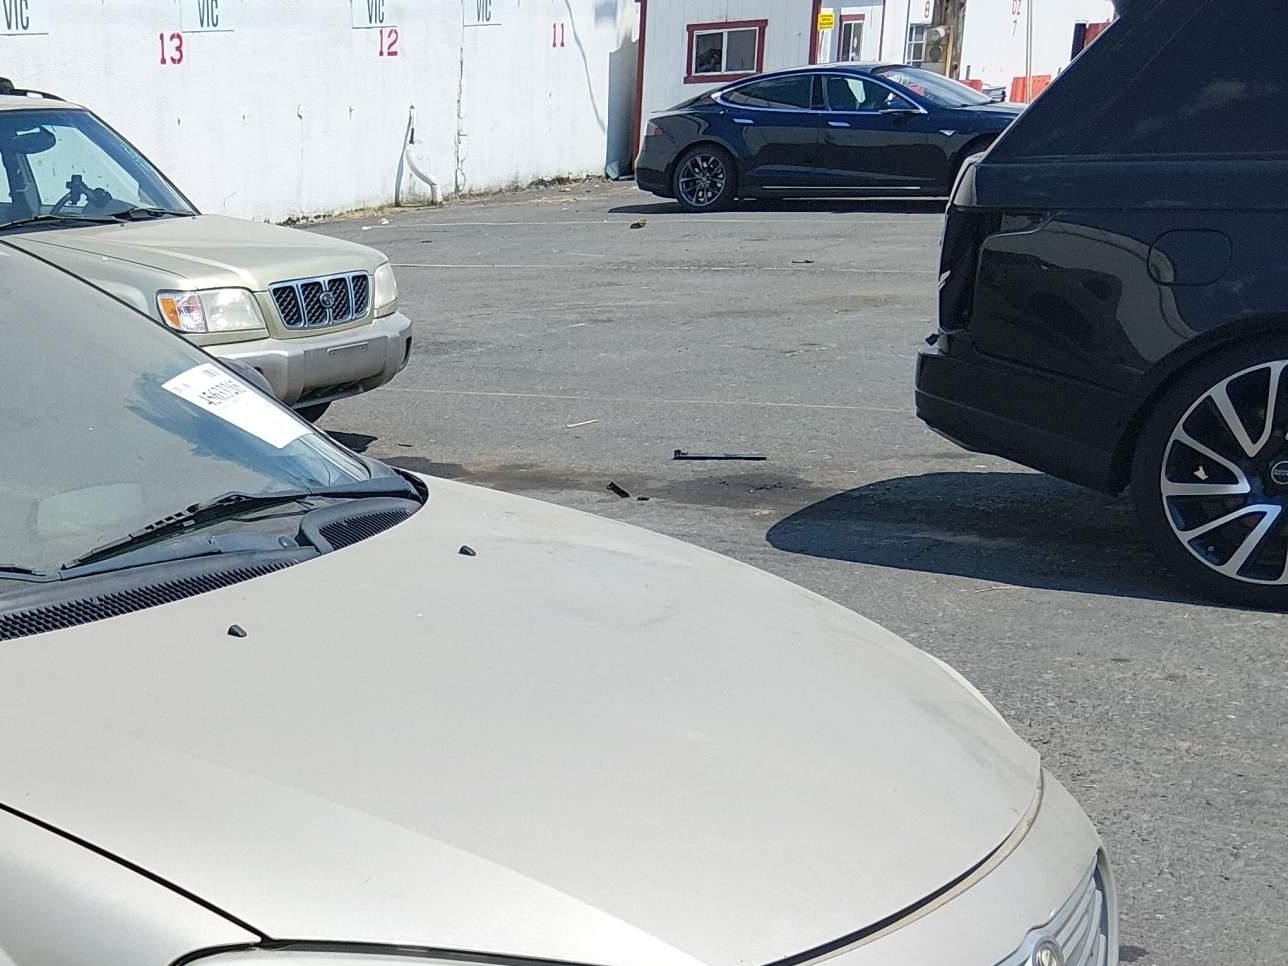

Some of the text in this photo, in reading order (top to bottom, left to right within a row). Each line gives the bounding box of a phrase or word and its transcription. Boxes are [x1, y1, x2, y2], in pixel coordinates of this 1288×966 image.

[379, 29, 399, 56] 12
[552, 23, 565, 47] 11
[159, 33, 184, 65] 13
